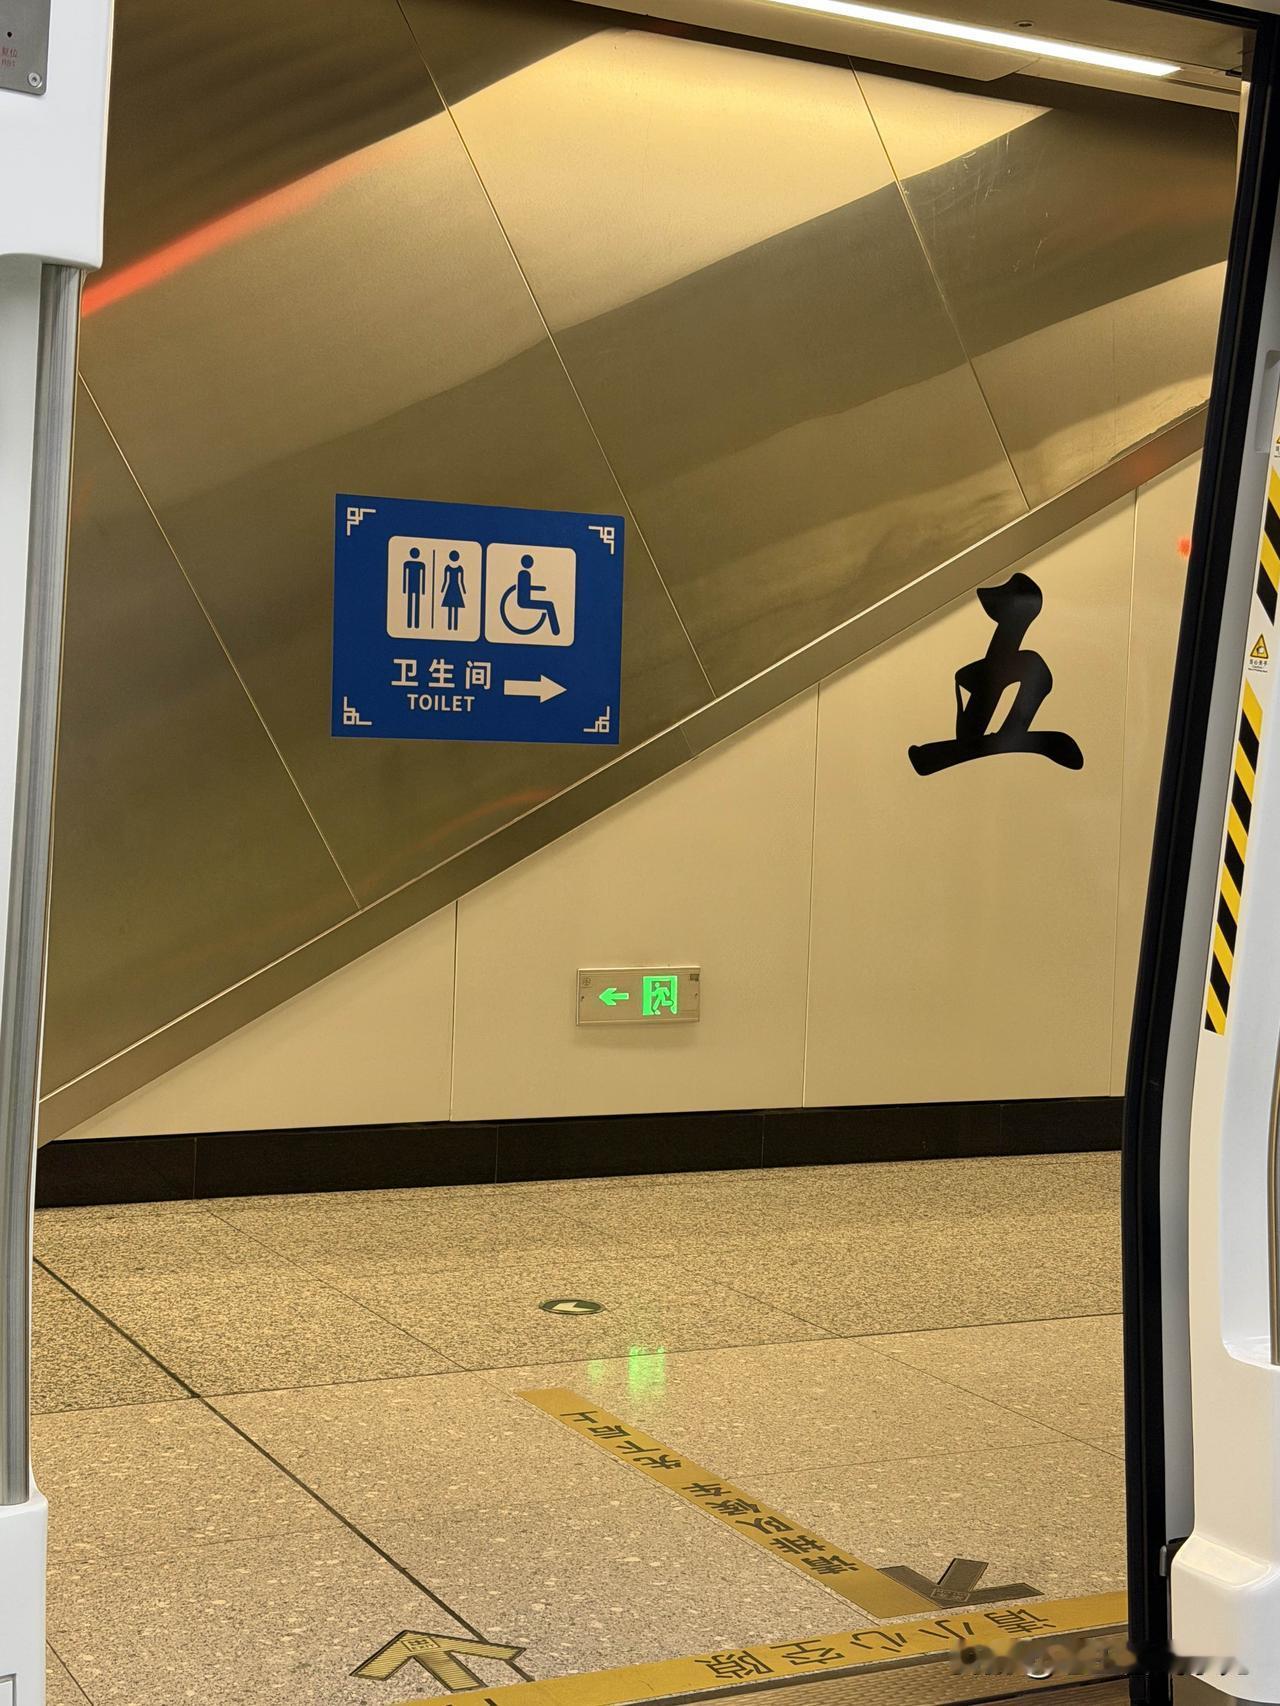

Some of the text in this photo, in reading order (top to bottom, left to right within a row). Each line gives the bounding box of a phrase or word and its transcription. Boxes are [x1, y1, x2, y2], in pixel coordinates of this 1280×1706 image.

[391, 658, 492, 690] 卫生间
[406, 693, 475, 712] TOILET
[908, 572, 1084, 777] 五
[559, 1410, 860, 1576] 请排队候车 先下后上
[695, 1608, 1057, 1680] 请小心空隙
